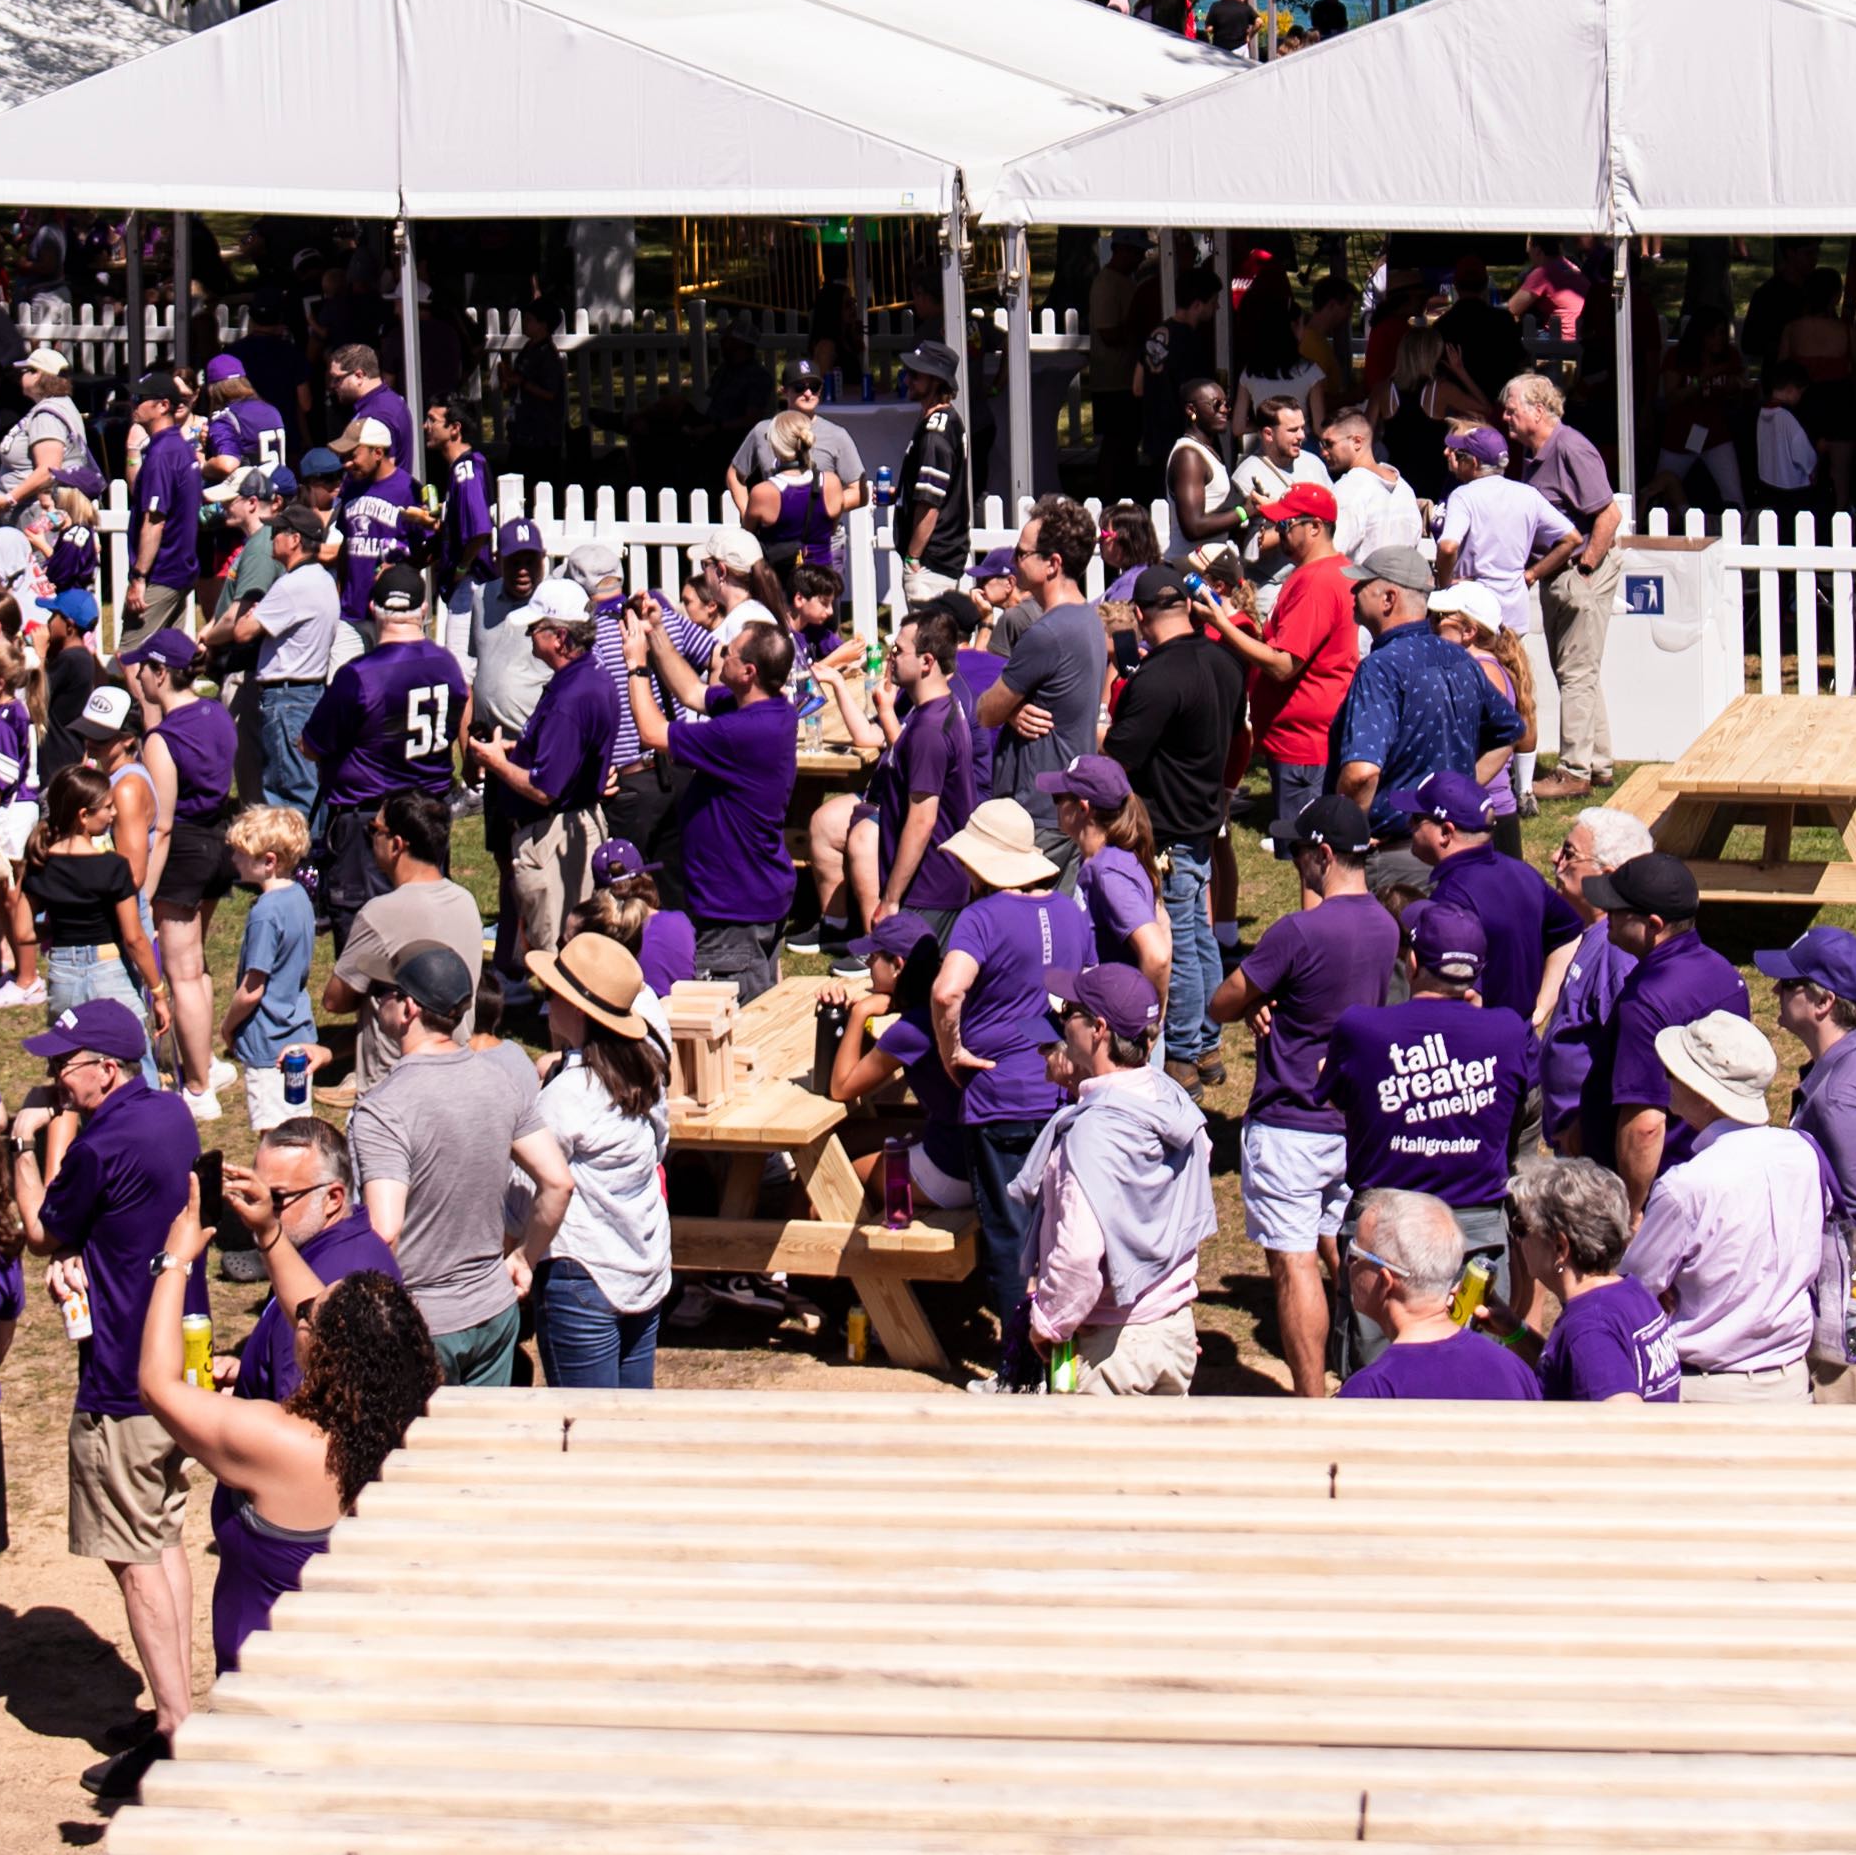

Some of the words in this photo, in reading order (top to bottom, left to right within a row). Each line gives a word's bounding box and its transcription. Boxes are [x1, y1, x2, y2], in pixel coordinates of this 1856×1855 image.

[926, 412, 949, 432] 51
[455, 460, 475, 483] 51
[517, 524, 530, 542] N
[405, 683, 449, 760] 51
[1389, 1033, 1449, 1075] tail
[1377, 1056, 1497, 1113] greater
[1404, 1102, 1427, 1124] at
[1429, 1086, 1497, 1120] meijer
[1390, 1135, 1481, 1157] #tailgreater
